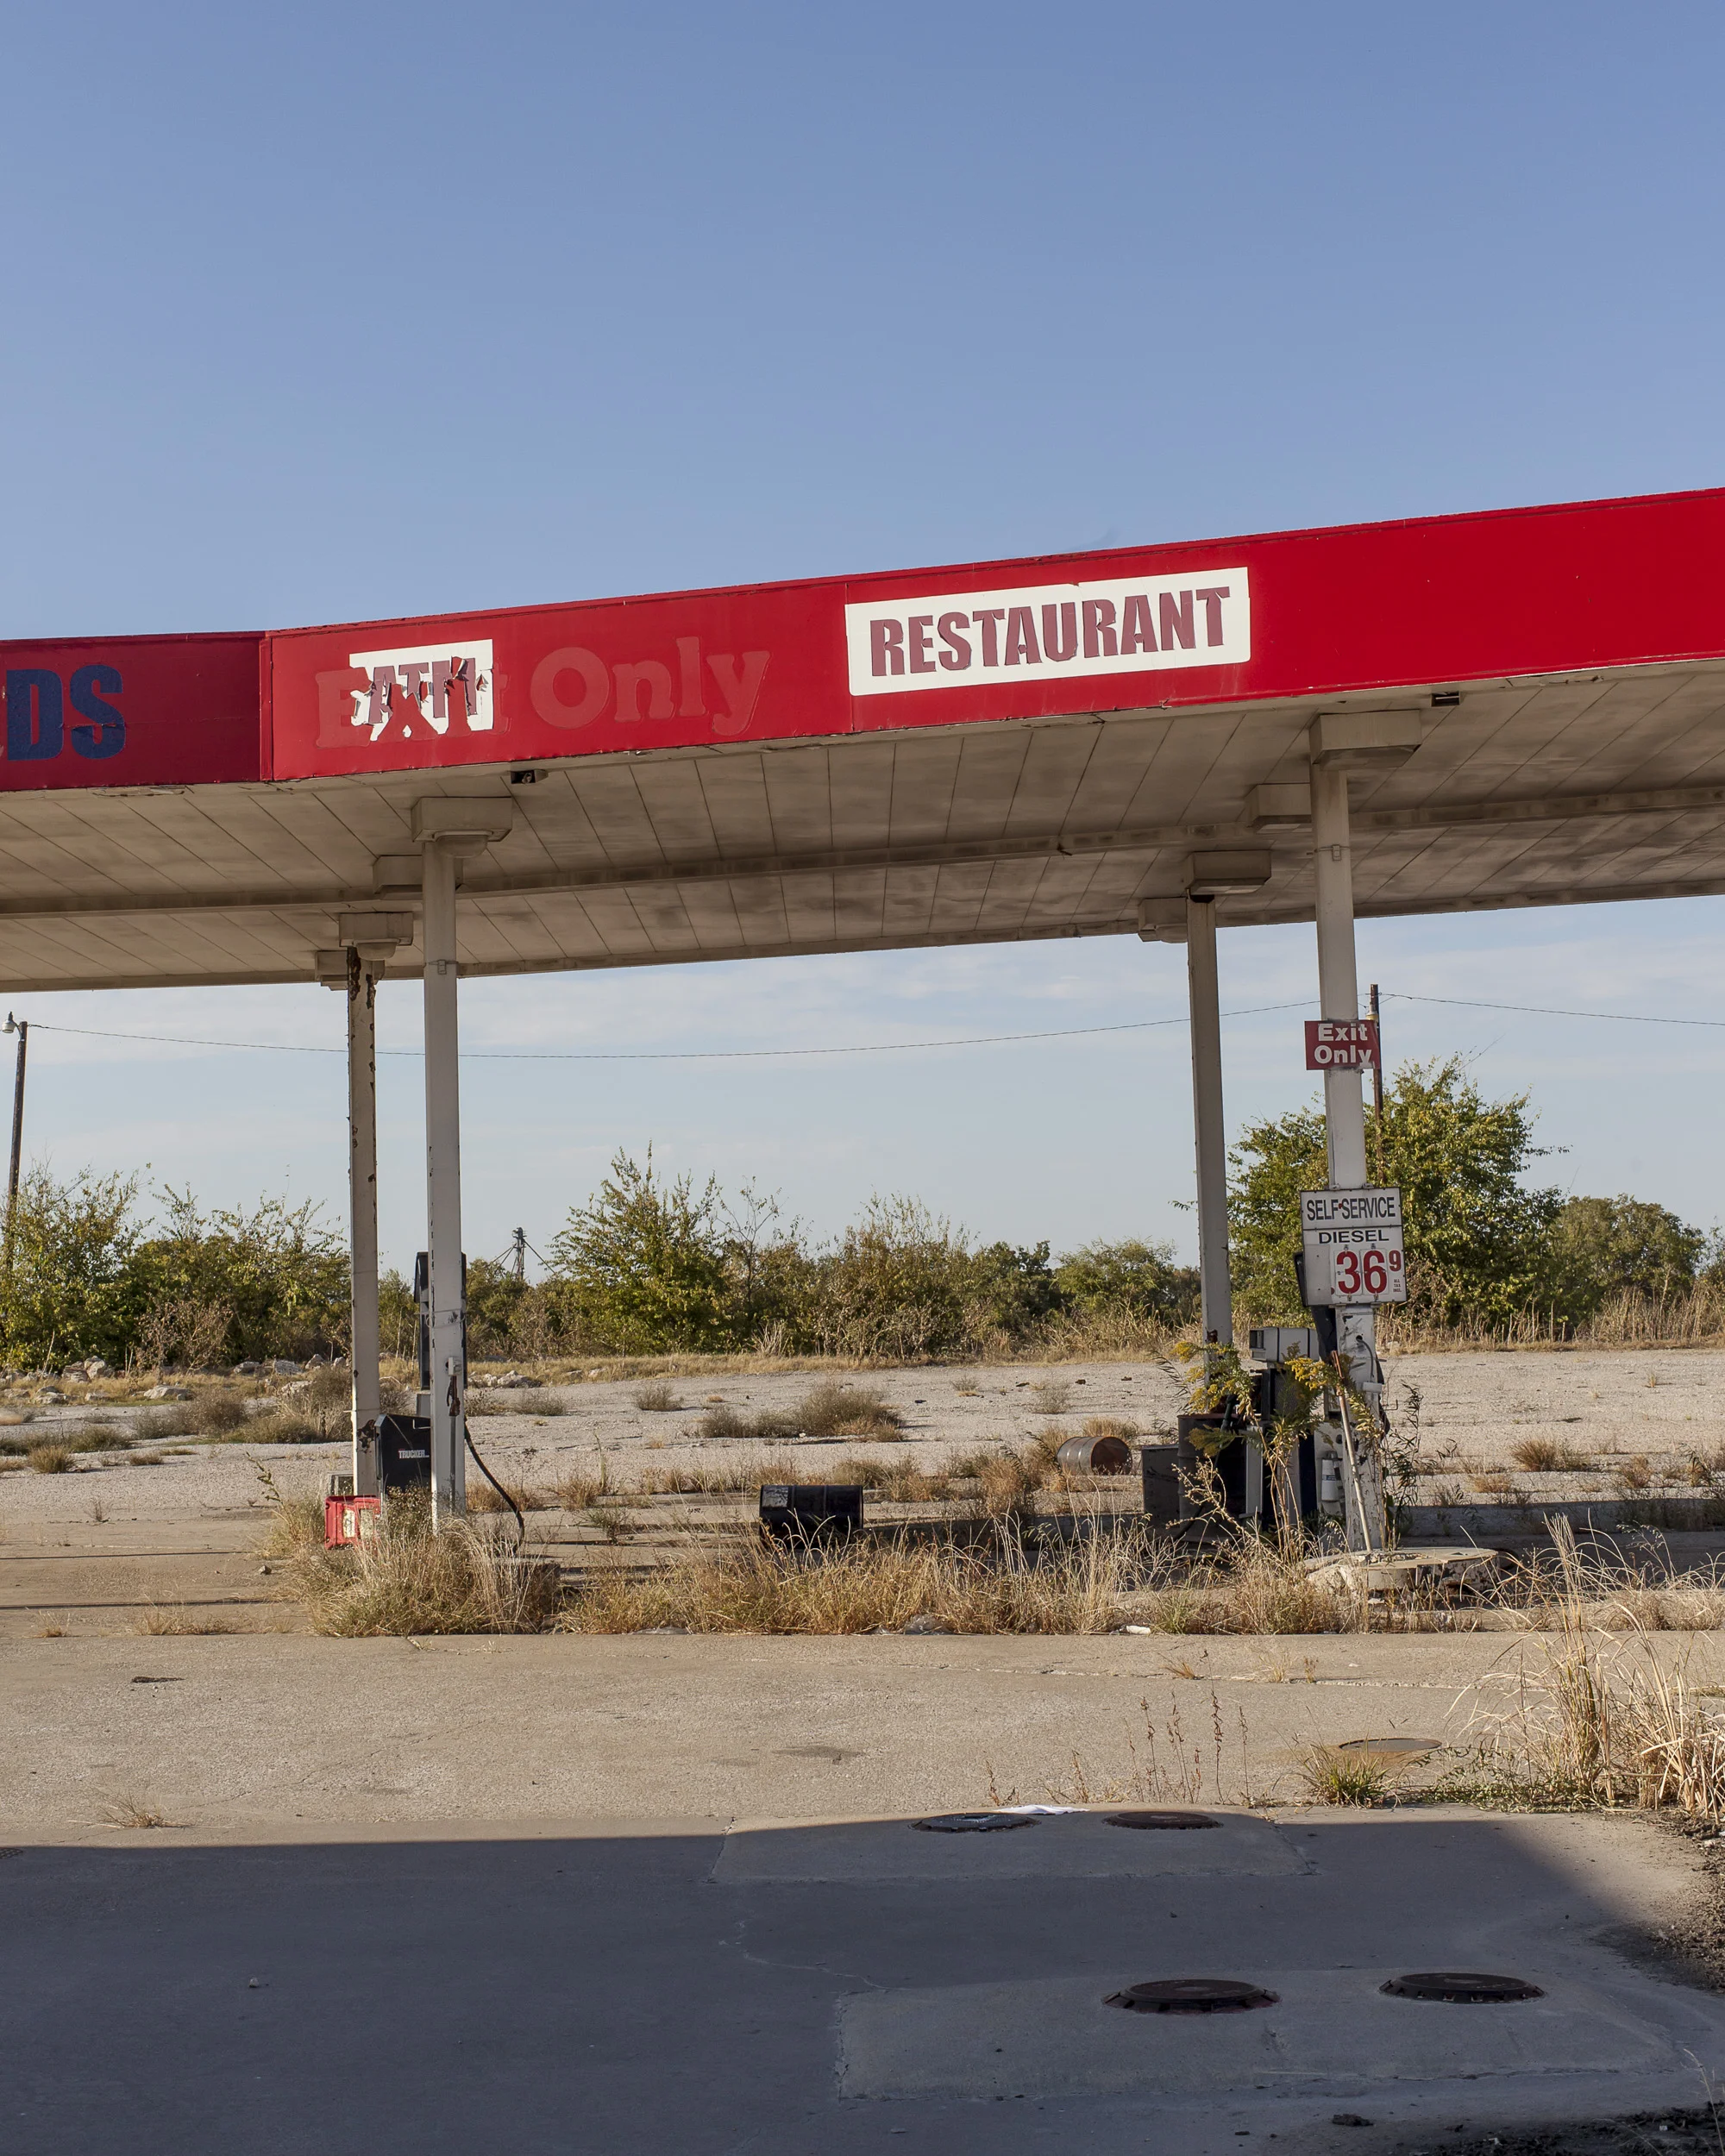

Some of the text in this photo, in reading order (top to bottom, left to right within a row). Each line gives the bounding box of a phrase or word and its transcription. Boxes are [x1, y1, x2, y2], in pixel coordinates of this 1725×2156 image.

[869, 586, 1230, 677] RESTAURANT
[5, 663, 127, 761] DS
[530, 636, 771, 736] Only
[1314, 1044, 1372, 1065] Only
[1318, 1023, 1368, 1042] Exit
[1318, 1230, 1389, 1244] DIESEL
